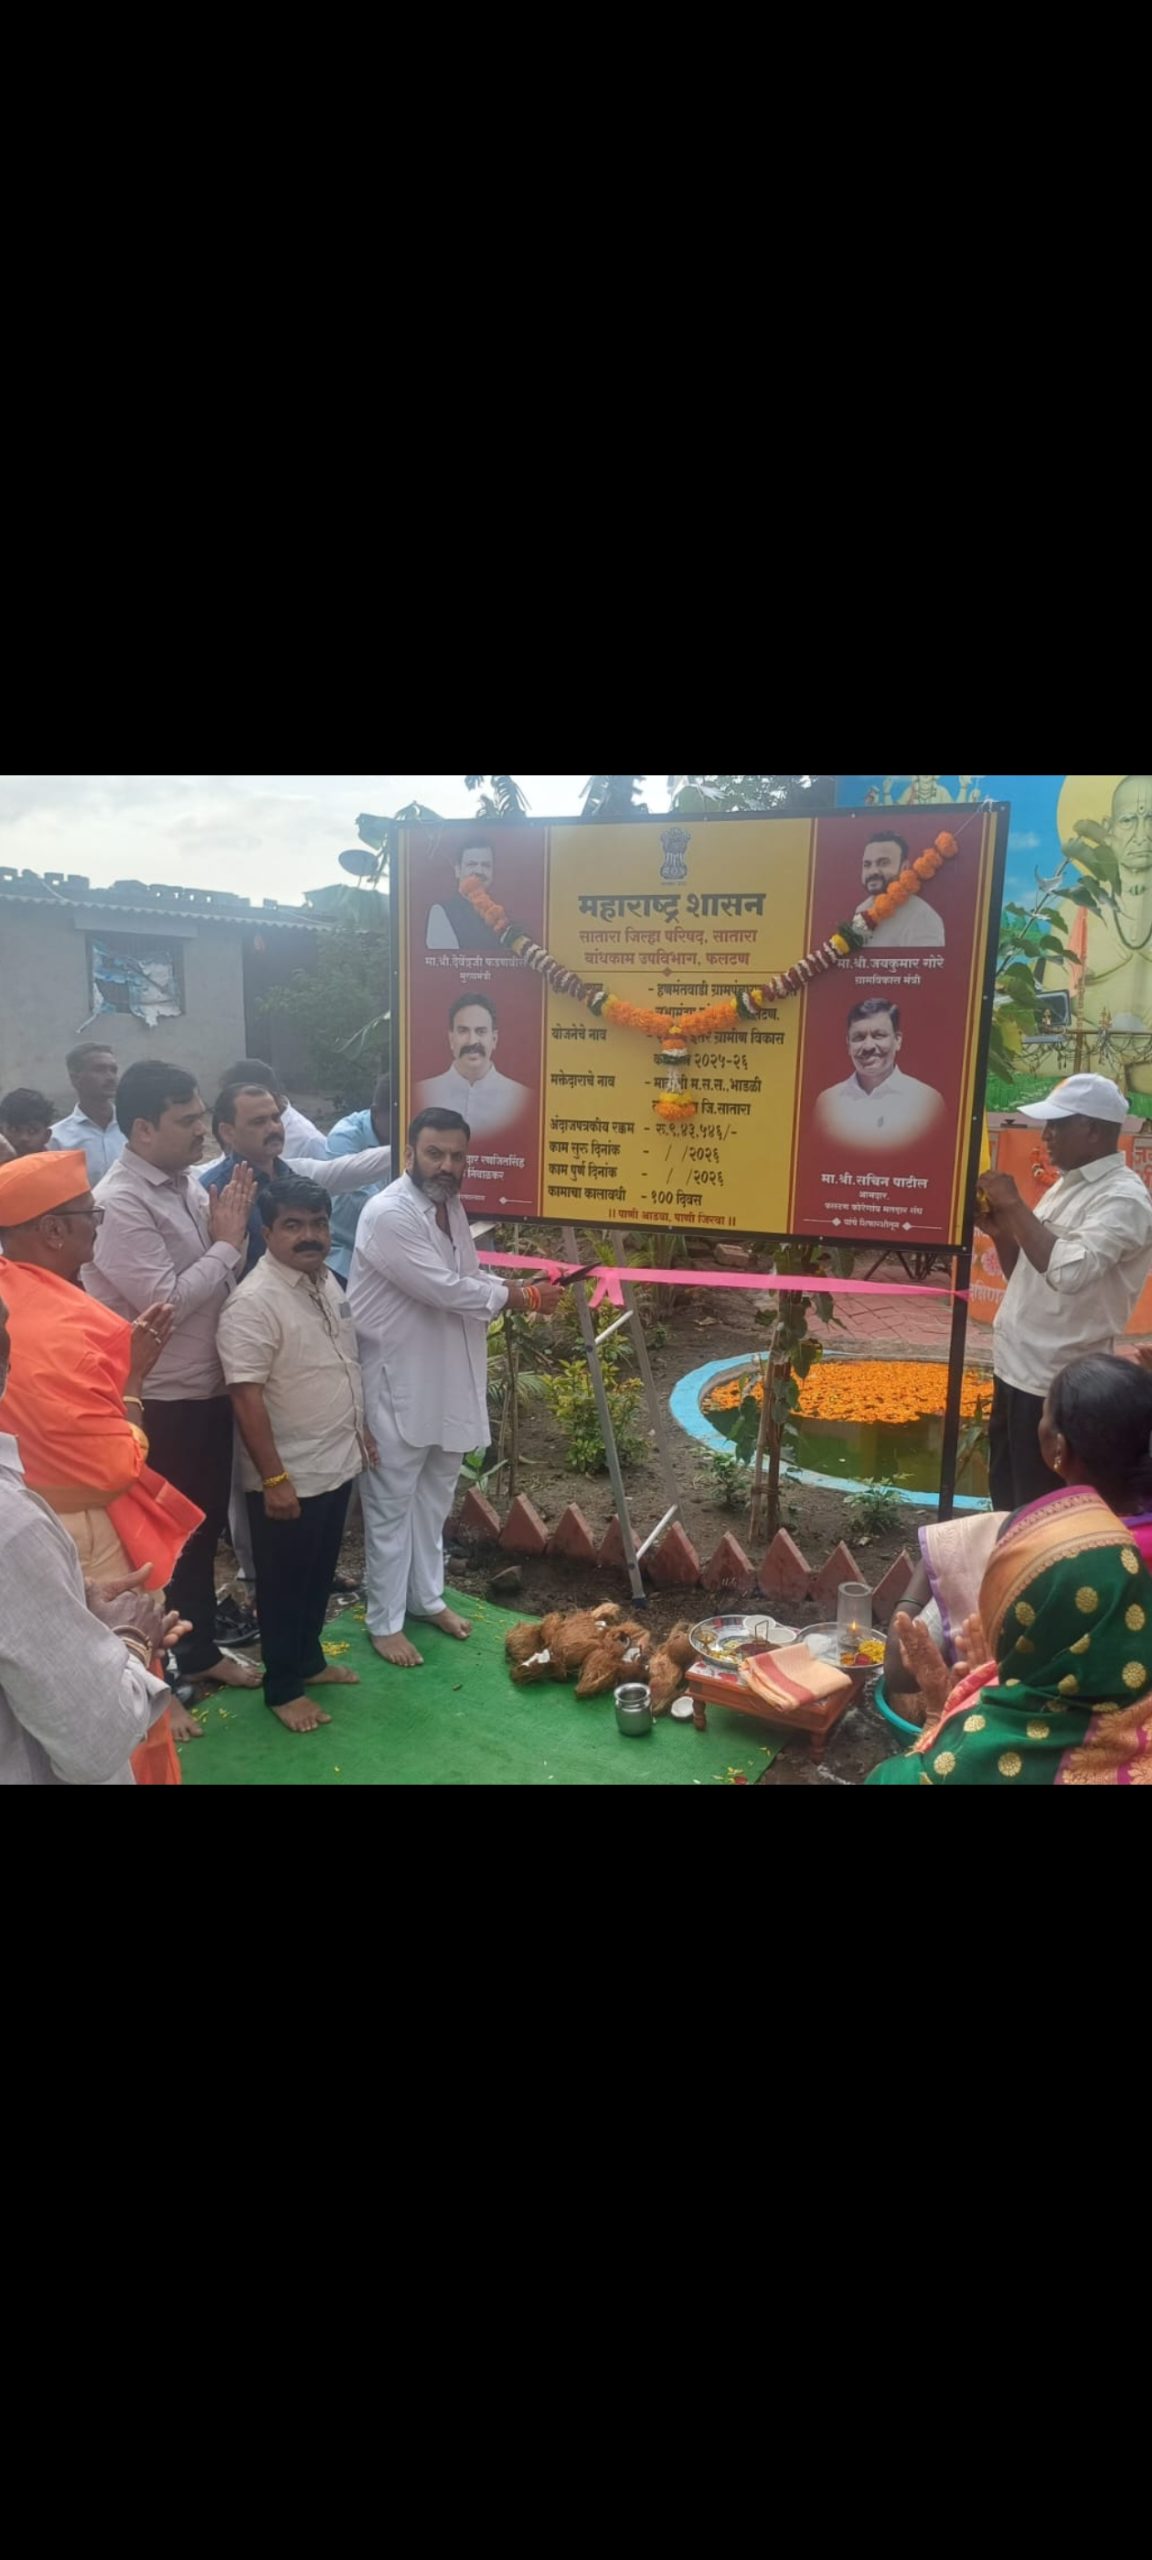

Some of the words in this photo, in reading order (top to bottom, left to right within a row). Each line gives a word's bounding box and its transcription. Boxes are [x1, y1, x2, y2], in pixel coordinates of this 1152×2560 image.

[578, 894, 681, 923] महाराष्ट्र
[686, 893, 767, 917] शासन
[579, 930, 621, 944] सातारा
[625, 926, 661, 945] जिल्हा
[713, 929, 758, 944] सातारा
[584, 948, 635, 966] बांधकाम
[706, 951, 751, 966] फलटण
[923, 954, 945, 969] गोरे
[551, 1023, 587, 1040] योजनेचे
[588, 1028, 608, 1040] नाव
[713, 1027, 748, 1045] ग्रामीण
[751, 1027, 785, 1045] विकास
[694, 1053, 748, 1070] २०२५-२६
[550, 1069, 595, 1088] मक्तेदाराचे
[597, 1075, 616, 1087] नाव
[550, 1115, 609, 1133] अंदाजपत्रकीय
[549, 1141, 569, 1153] काम
[591, 1139, 621, 1158] दिनांक
[548, 1163, 568, 1175] काम
[588, 1161, 618, 1180] दिनांक
[893, 1174, 929, 1189] पाटील
[547, 1185, 582, 1198] कामाचा
[584, 1185, 626, 1201] कालावधी
[676, 1189, 703, 1207] दिवस
[618, 1208, 639, 1219] पाणी
[674, 1211, 695, 1223] पाणी
